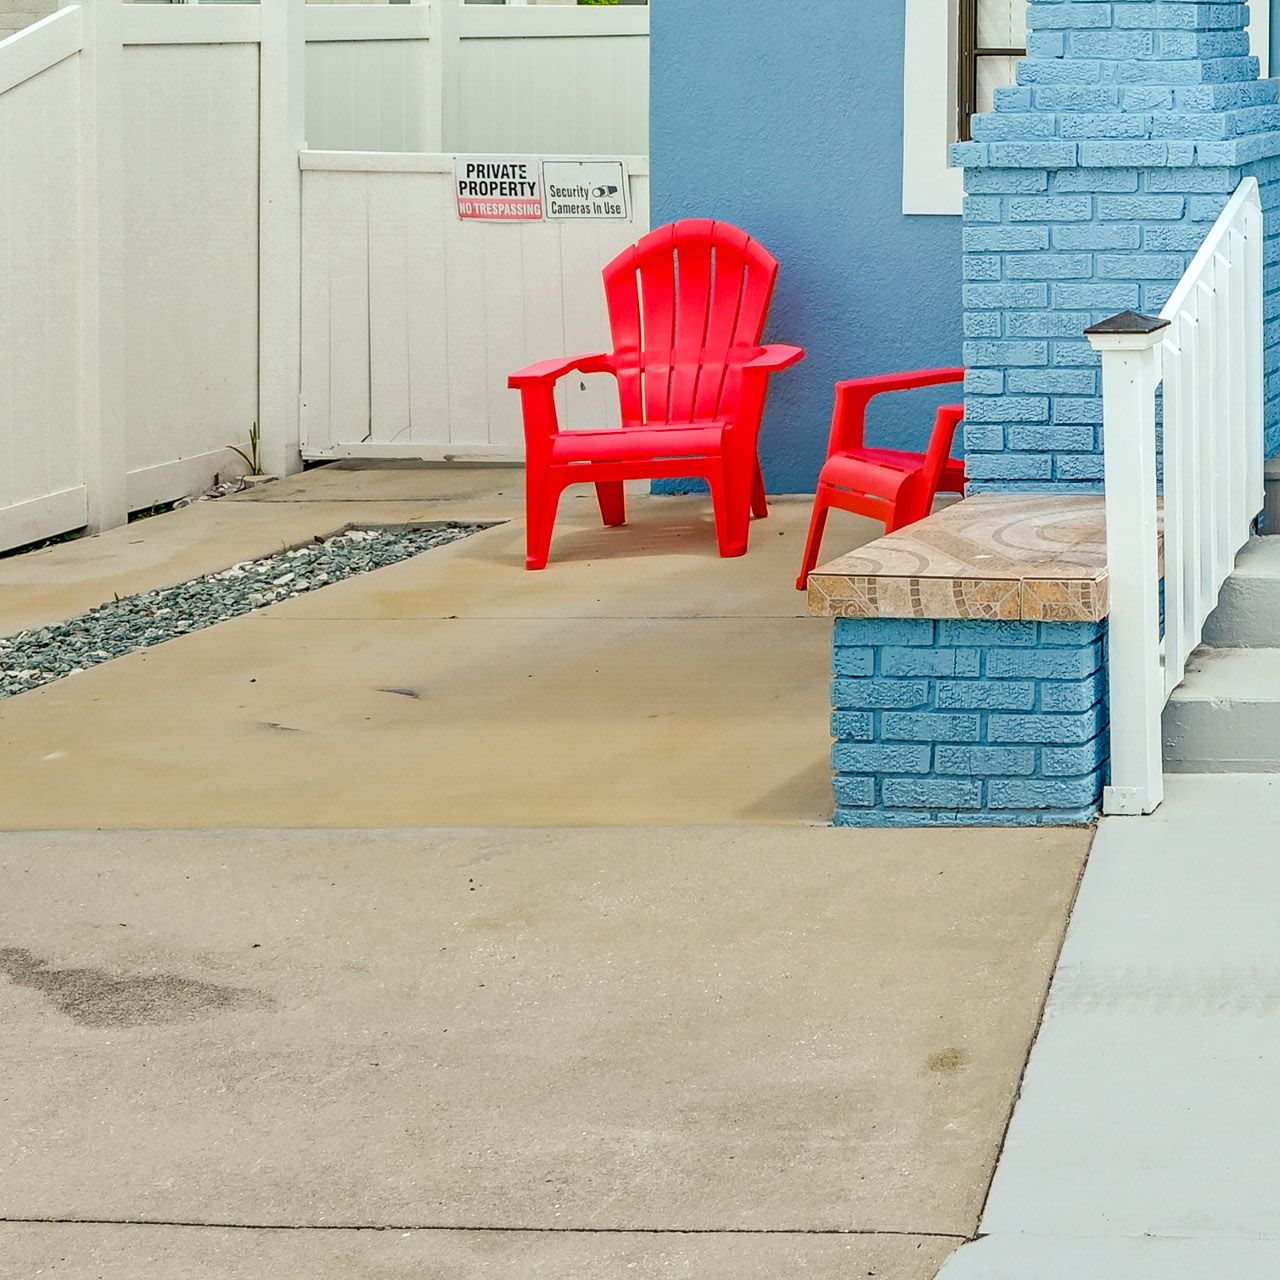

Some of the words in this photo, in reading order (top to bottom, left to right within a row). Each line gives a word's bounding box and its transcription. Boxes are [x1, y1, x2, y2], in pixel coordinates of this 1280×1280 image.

[466, 163, 527, 180] PRIVATE
[458, 180, 536, 197] PROPERTY
[549, 184, 589, 201] Security
[459, 202, 472, 214] NO
[474, 202, 541, 216] TRESPASSING
[551, 201, 591, 215] Cameras
[593, 201, 602, 214] In
[604, 201, 621, 215] Use
